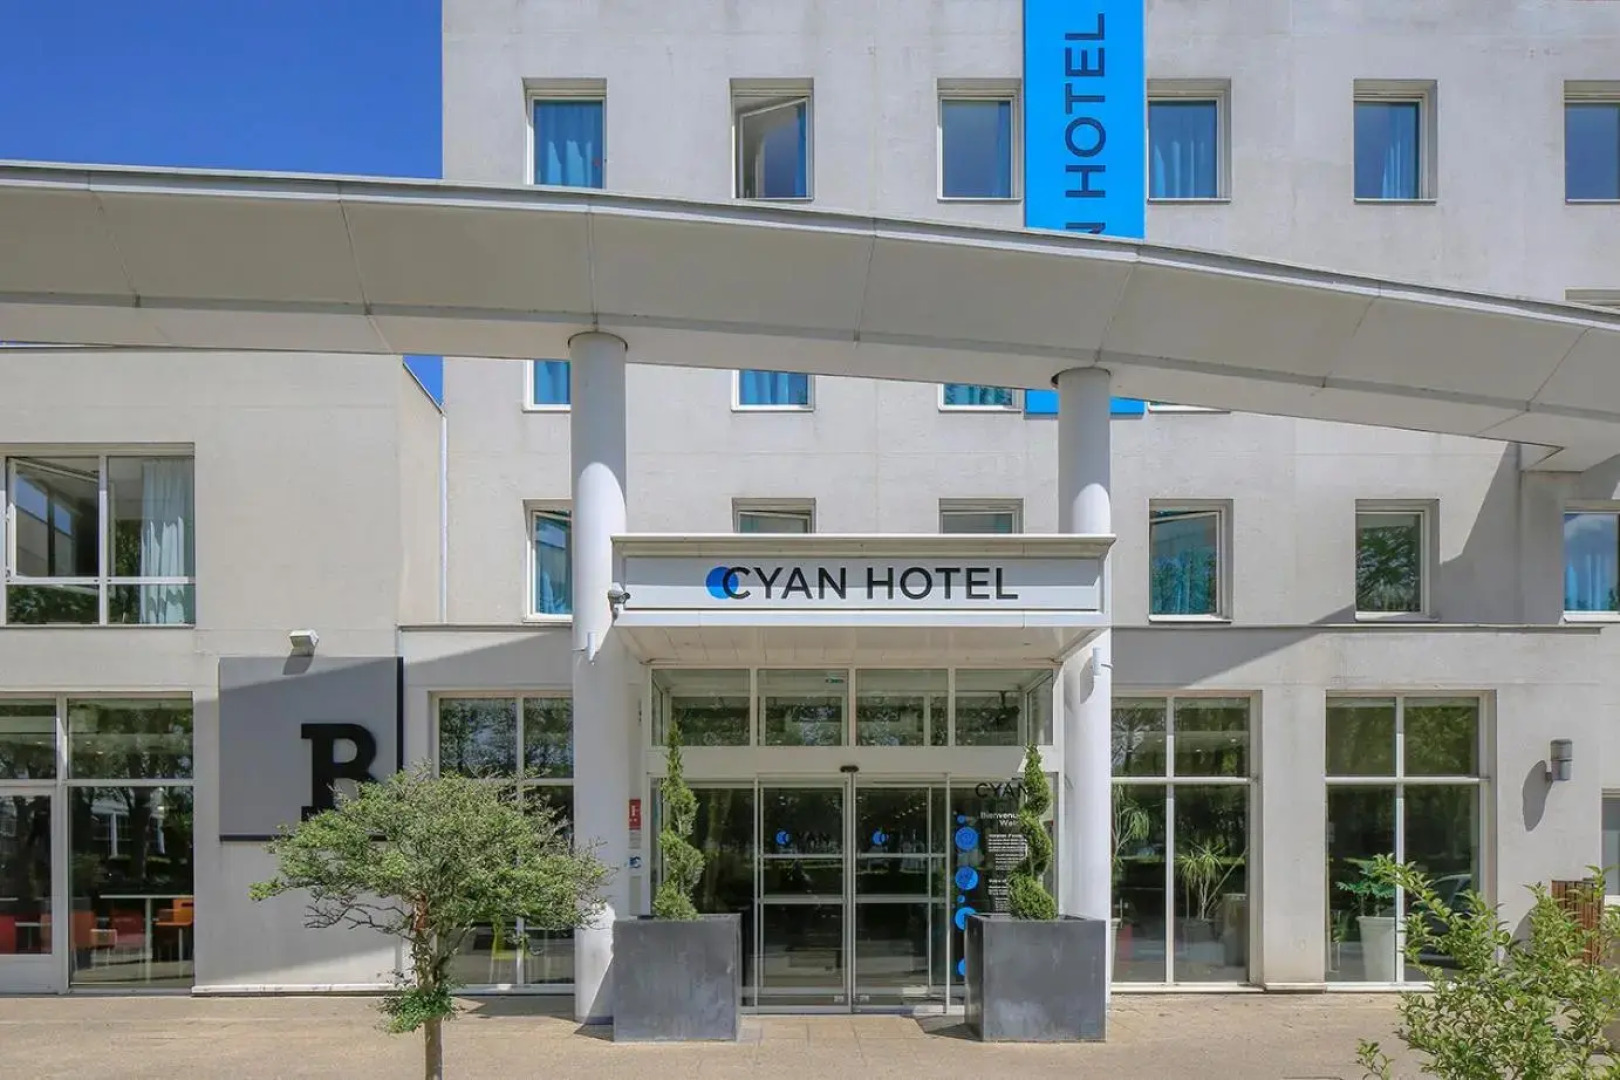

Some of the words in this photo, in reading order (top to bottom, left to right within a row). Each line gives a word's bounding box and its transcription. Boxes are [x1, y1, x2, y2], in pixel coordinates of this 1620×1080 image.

[1065, 13, 1106, 198] HOTEL
[722, 566, 847, 600] CYAN
[867, 566, 1018, 600] HOTEL
[301, 723, 383, 822] R
